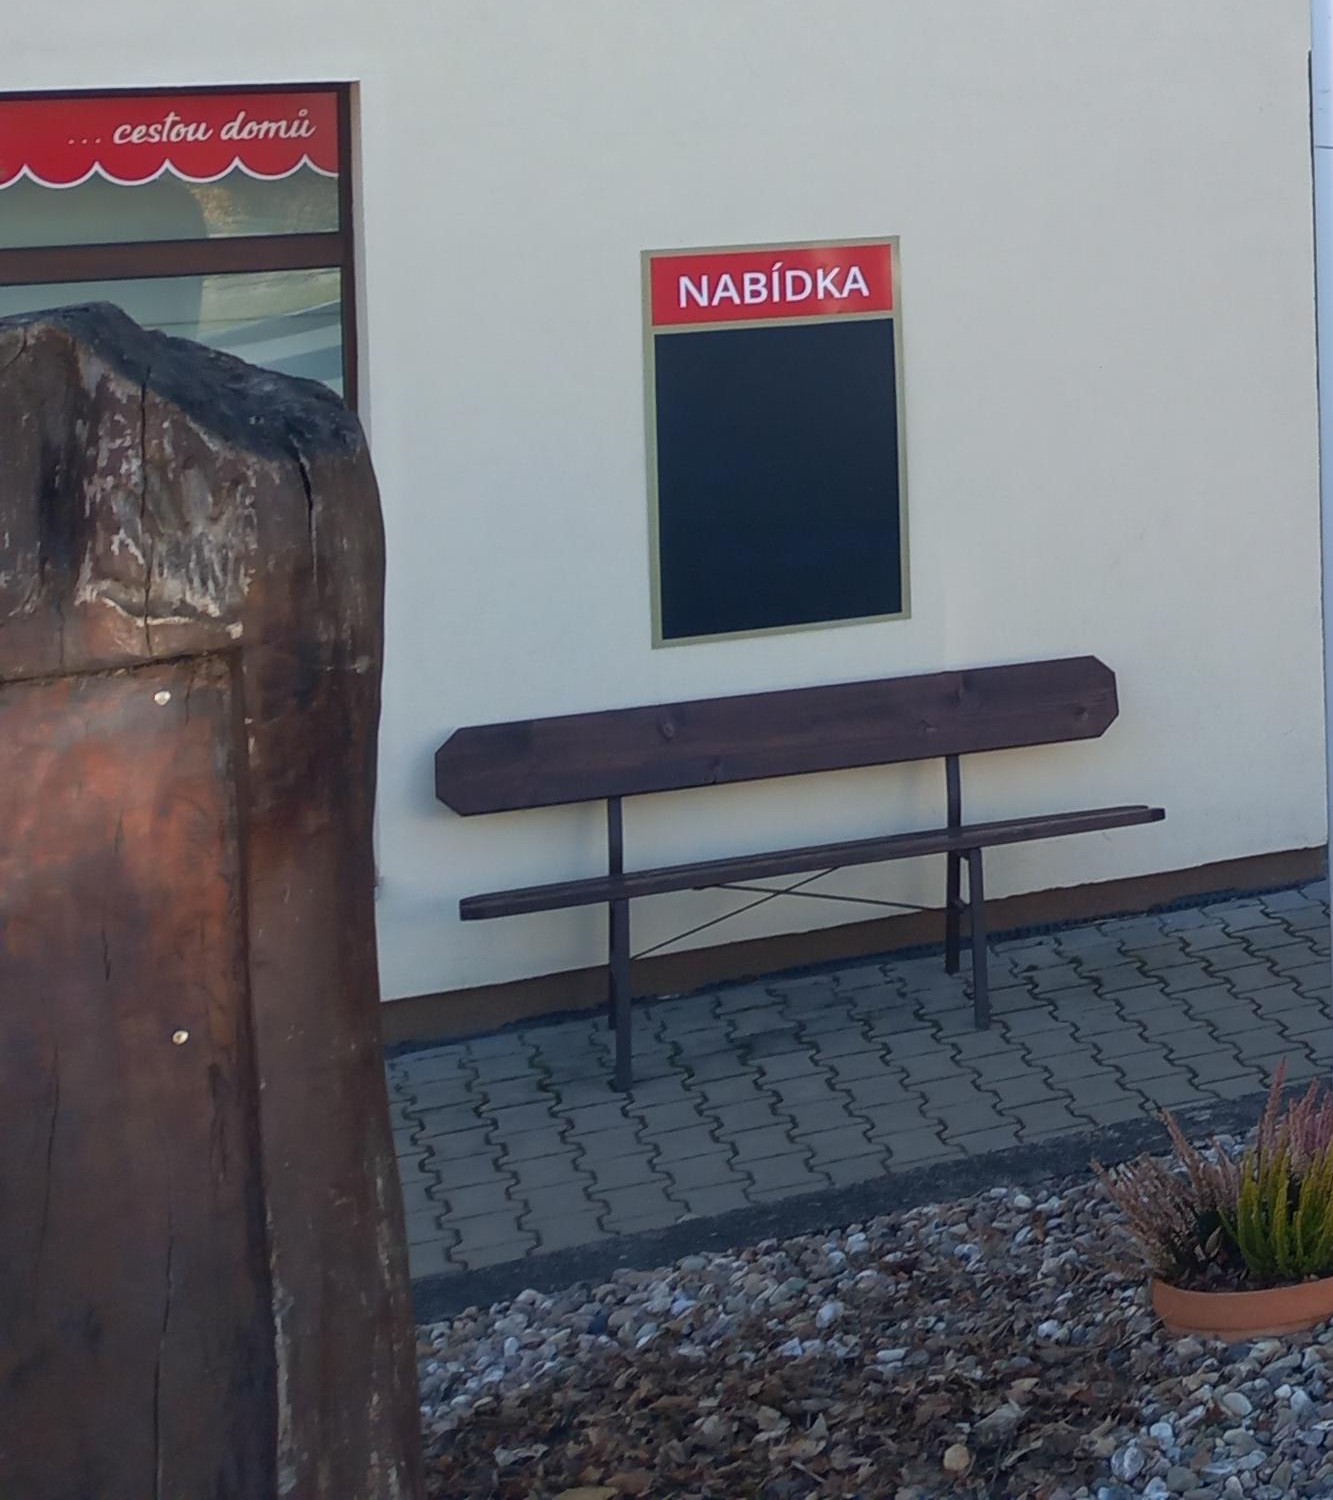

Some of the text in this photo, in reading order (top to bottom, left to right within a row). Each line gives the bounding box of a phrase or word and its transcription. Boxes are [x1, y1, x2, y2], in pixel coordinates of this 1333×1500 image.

[113, 111, 213, 145] cestou
[220, 109, 316, 141] domů
[679, 261, 870, 309] NABÍDKA
